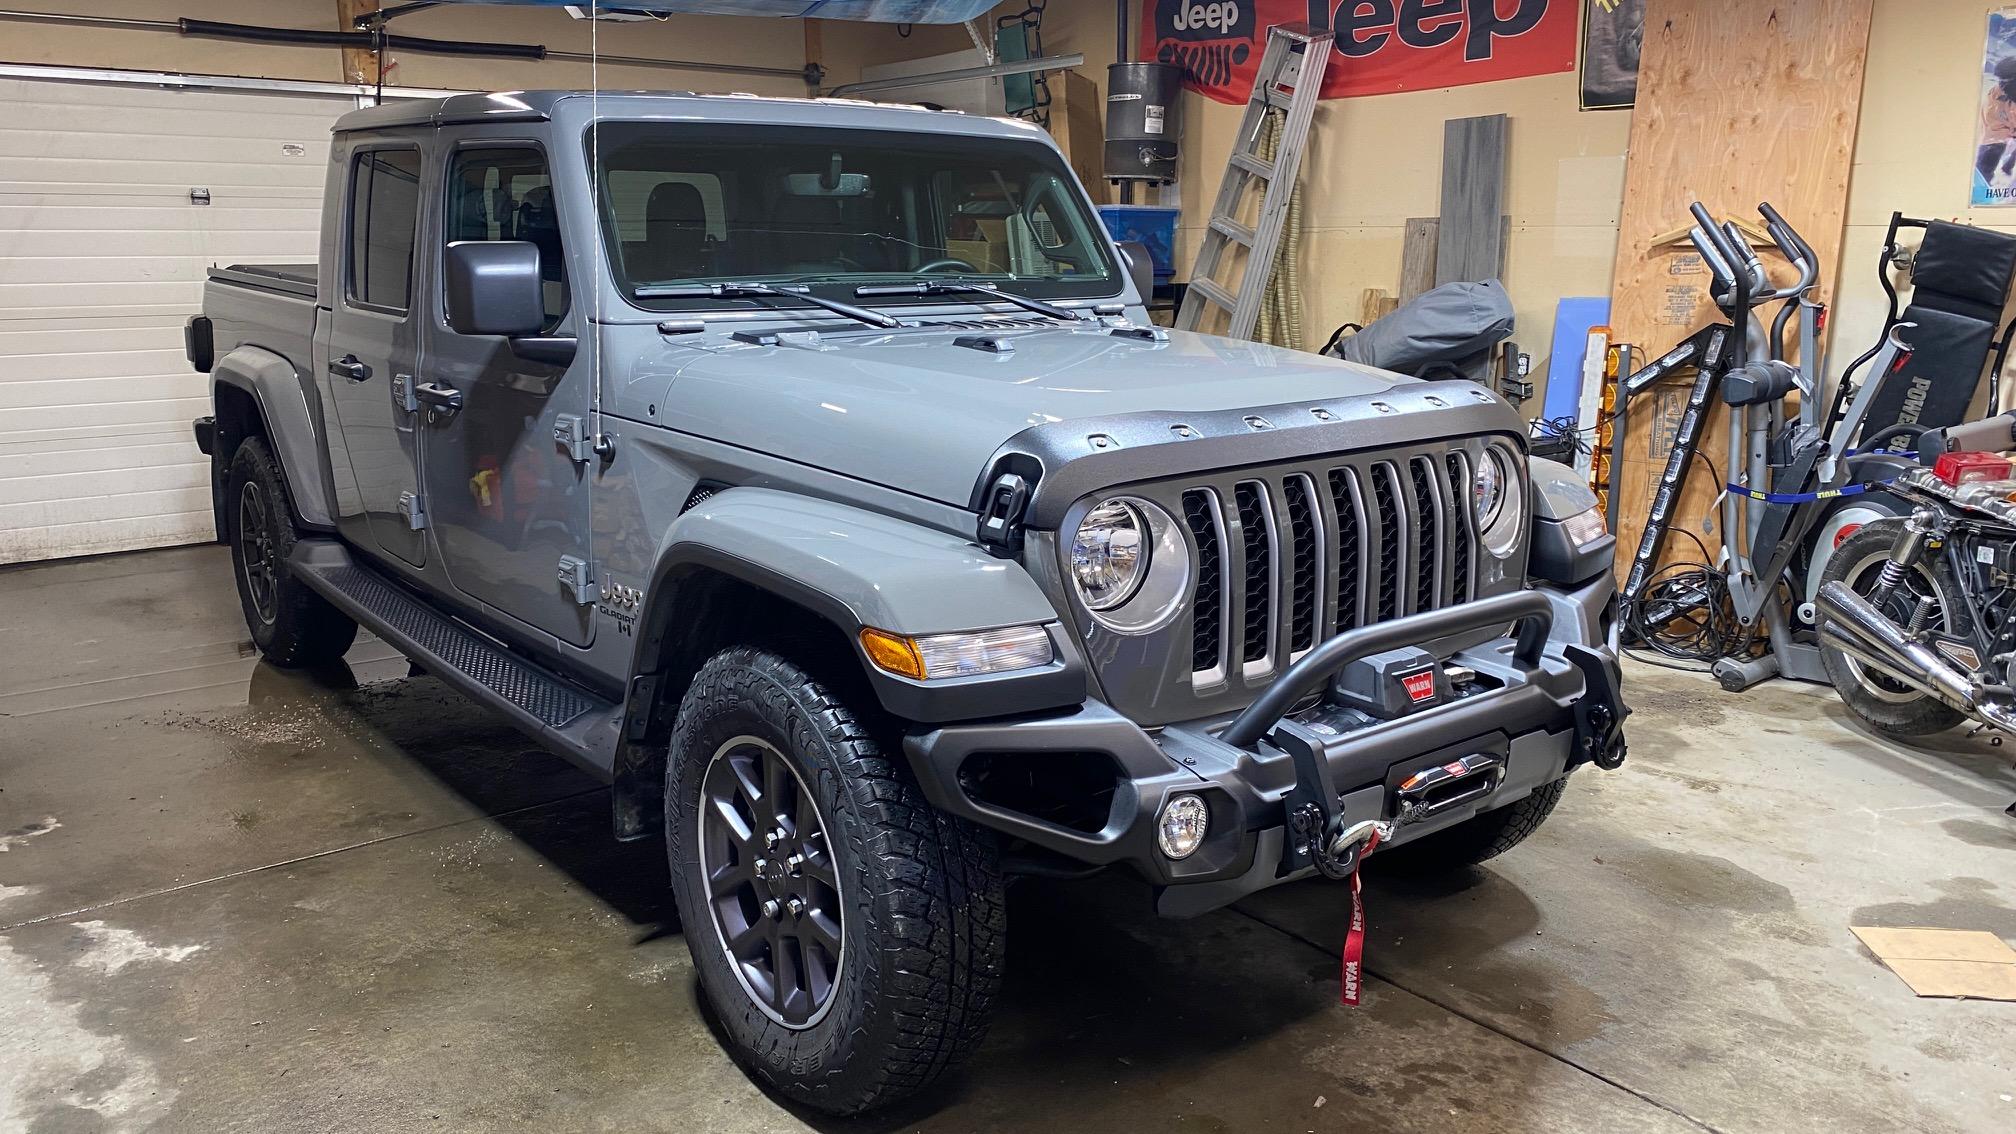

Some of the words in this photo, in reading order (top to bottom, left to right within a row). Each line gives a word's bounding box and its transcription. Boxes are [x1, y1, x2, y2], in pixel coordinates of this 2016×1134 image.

[1173, 0, 1239, 34] Jeep
[1985, 188, 2010, 198] HAVE
[1816, 489, 1842, 499] THULE
[601, 573, 643, 615] Jeep
[600, 605, 636, 625] GLADIAT
[1408, 680, 1431, 694] WARN
[1352, 890, 1362, 932] WARN
[1345, 961, 1358, 1001] WARN
